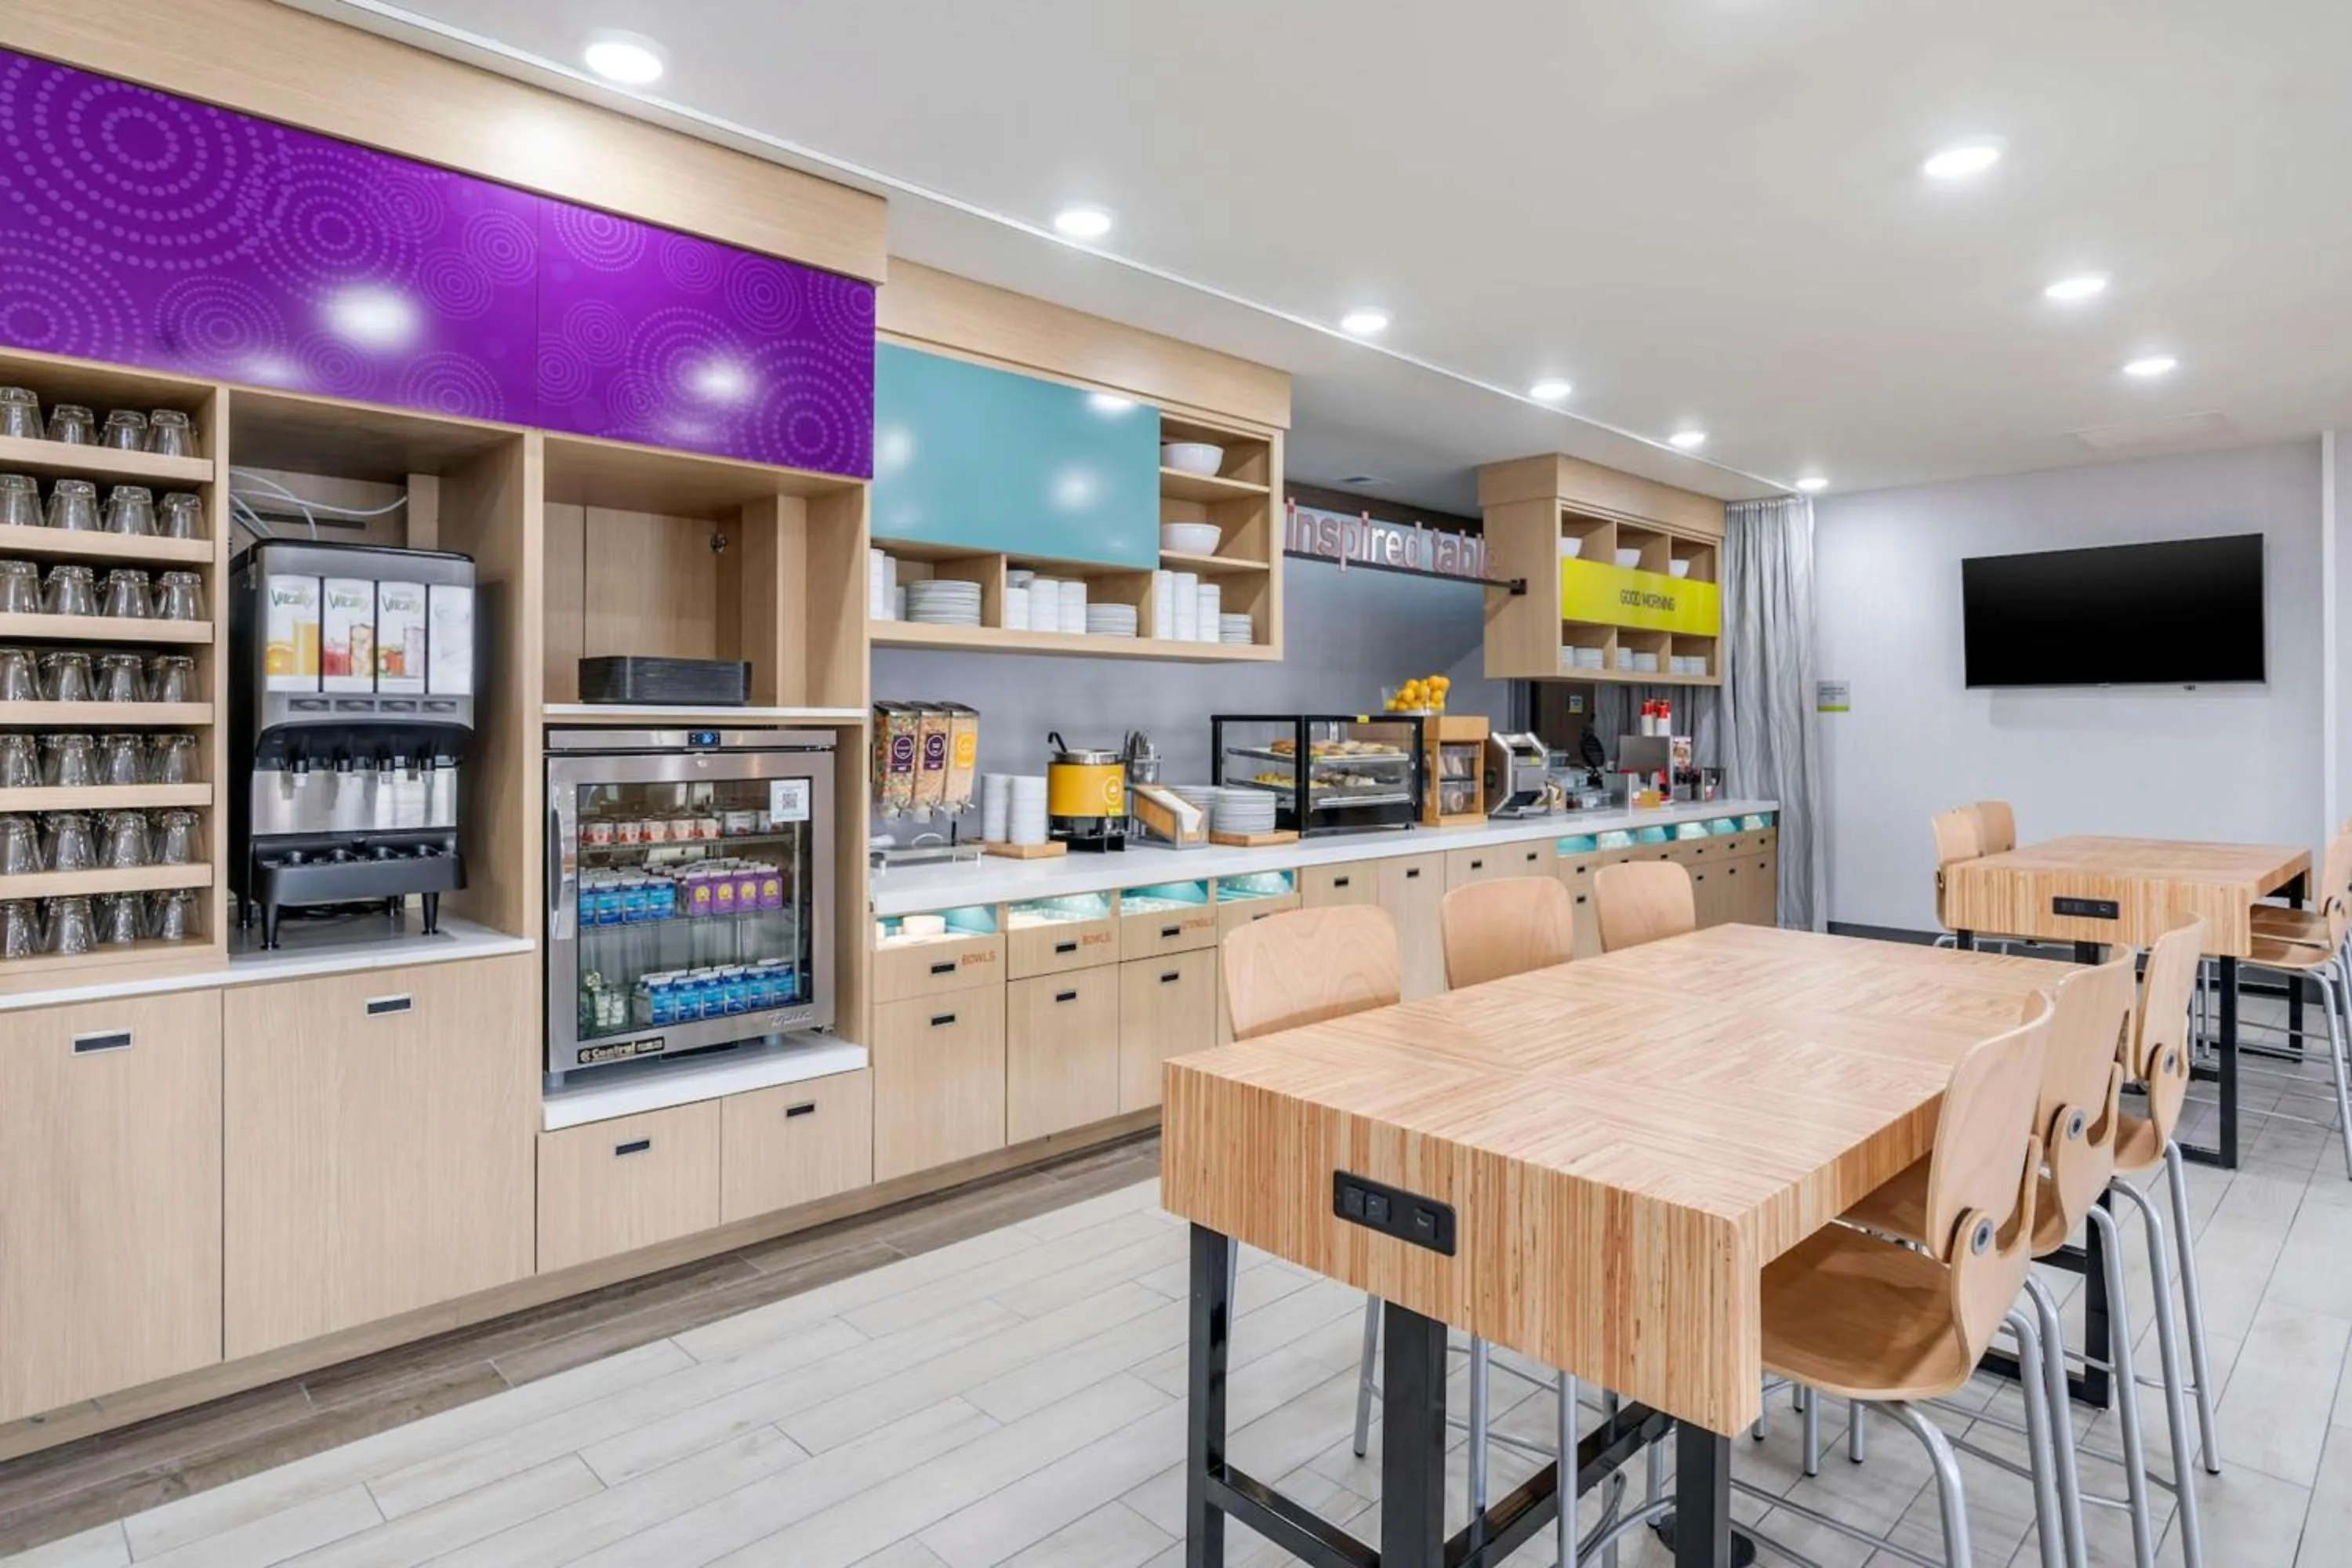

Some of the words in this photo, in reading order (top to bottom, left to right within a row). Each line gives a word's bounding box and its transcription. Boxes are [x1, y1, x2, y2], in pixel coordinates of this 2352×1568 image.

[1284, 497, 1422, 572] inspired
[1619, 590, 1641, 607] GOOD
[1642, 593, 1675, 612] MORNING
[1081, 931, 1112, 946] BOWLS
[961, 949, 996, 966] BOWLS
